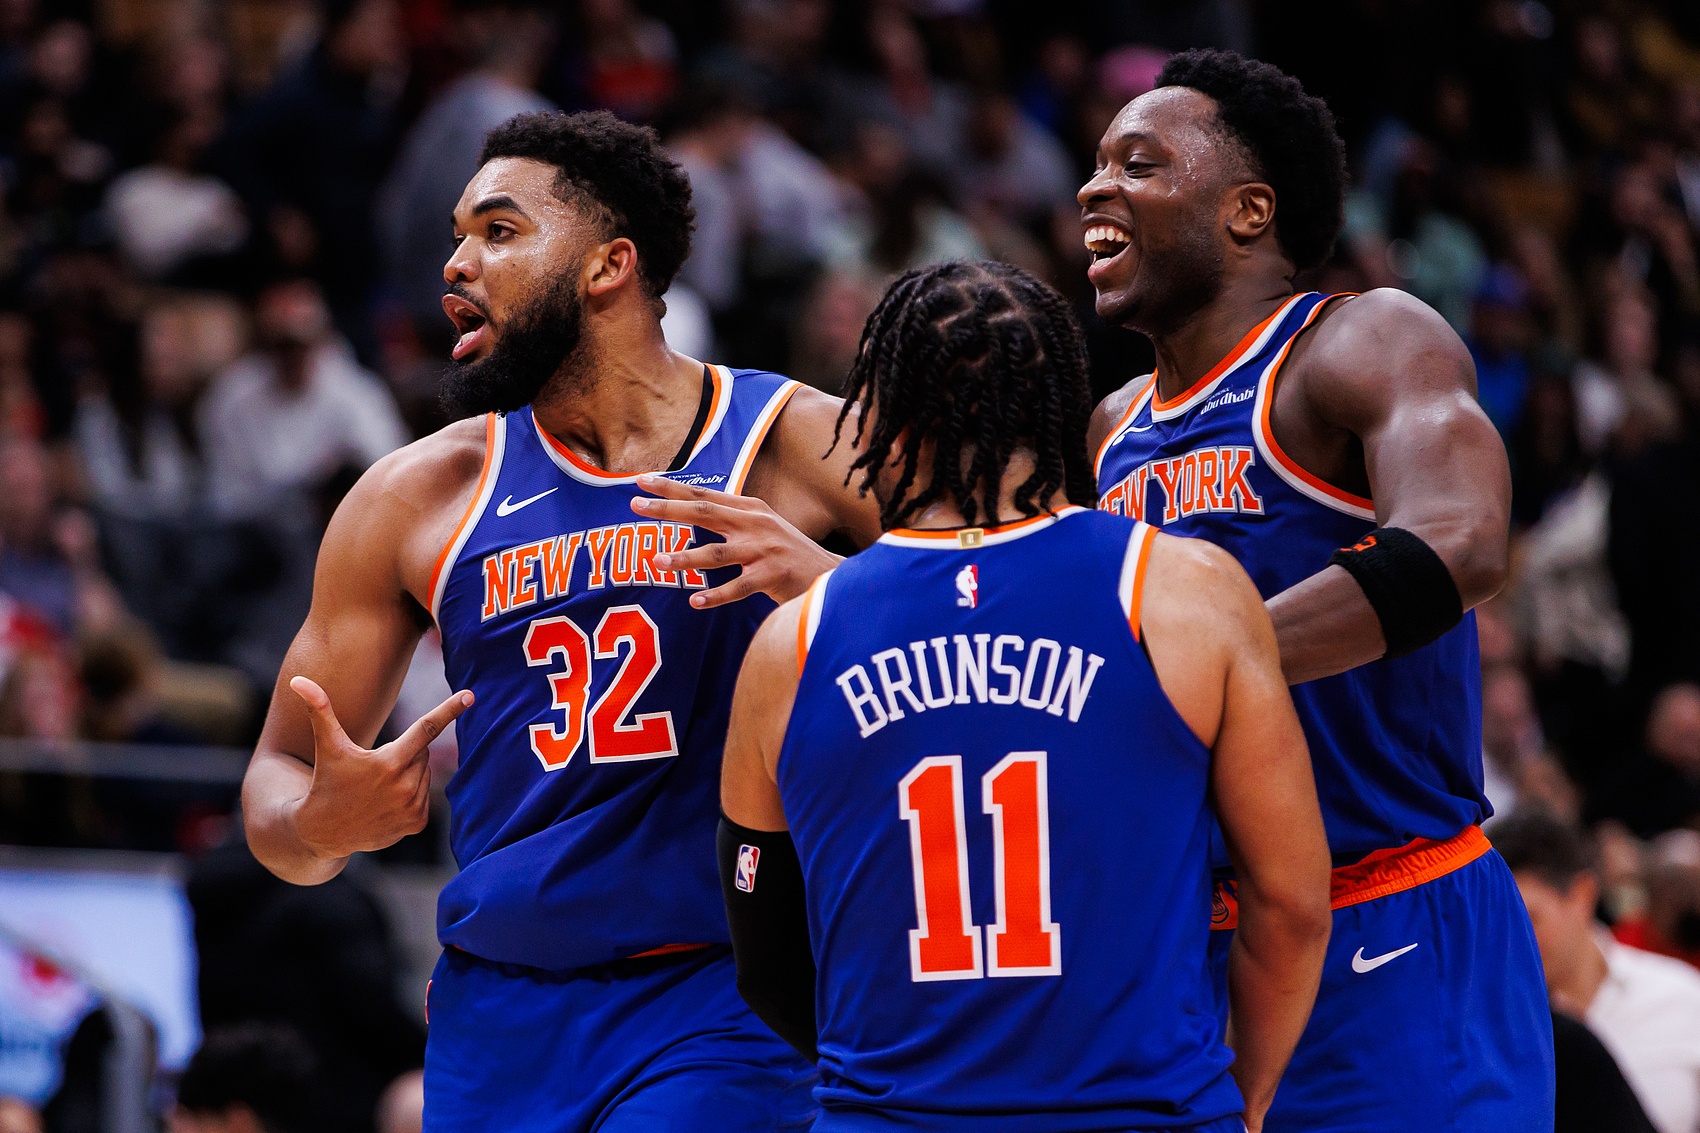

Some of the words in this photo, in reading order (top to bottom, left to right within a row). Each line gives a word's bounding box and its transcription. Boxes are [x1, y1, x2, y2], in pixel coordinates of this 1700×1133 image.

[1200, 398, 1219, 415] abu
[1220, 385, 1256, 405] dhabi
[1098, 462, 1150, 522] EW
[1151, 445, 1265, 525] YORK
[481, 530, 585, 623] NEW
[587, 521, 709, 590] YORK
[522, 604, 679, 772] 32
[836, 633, 1105, 738] BRUNSON
[899, 751, 1062, 982] 11
